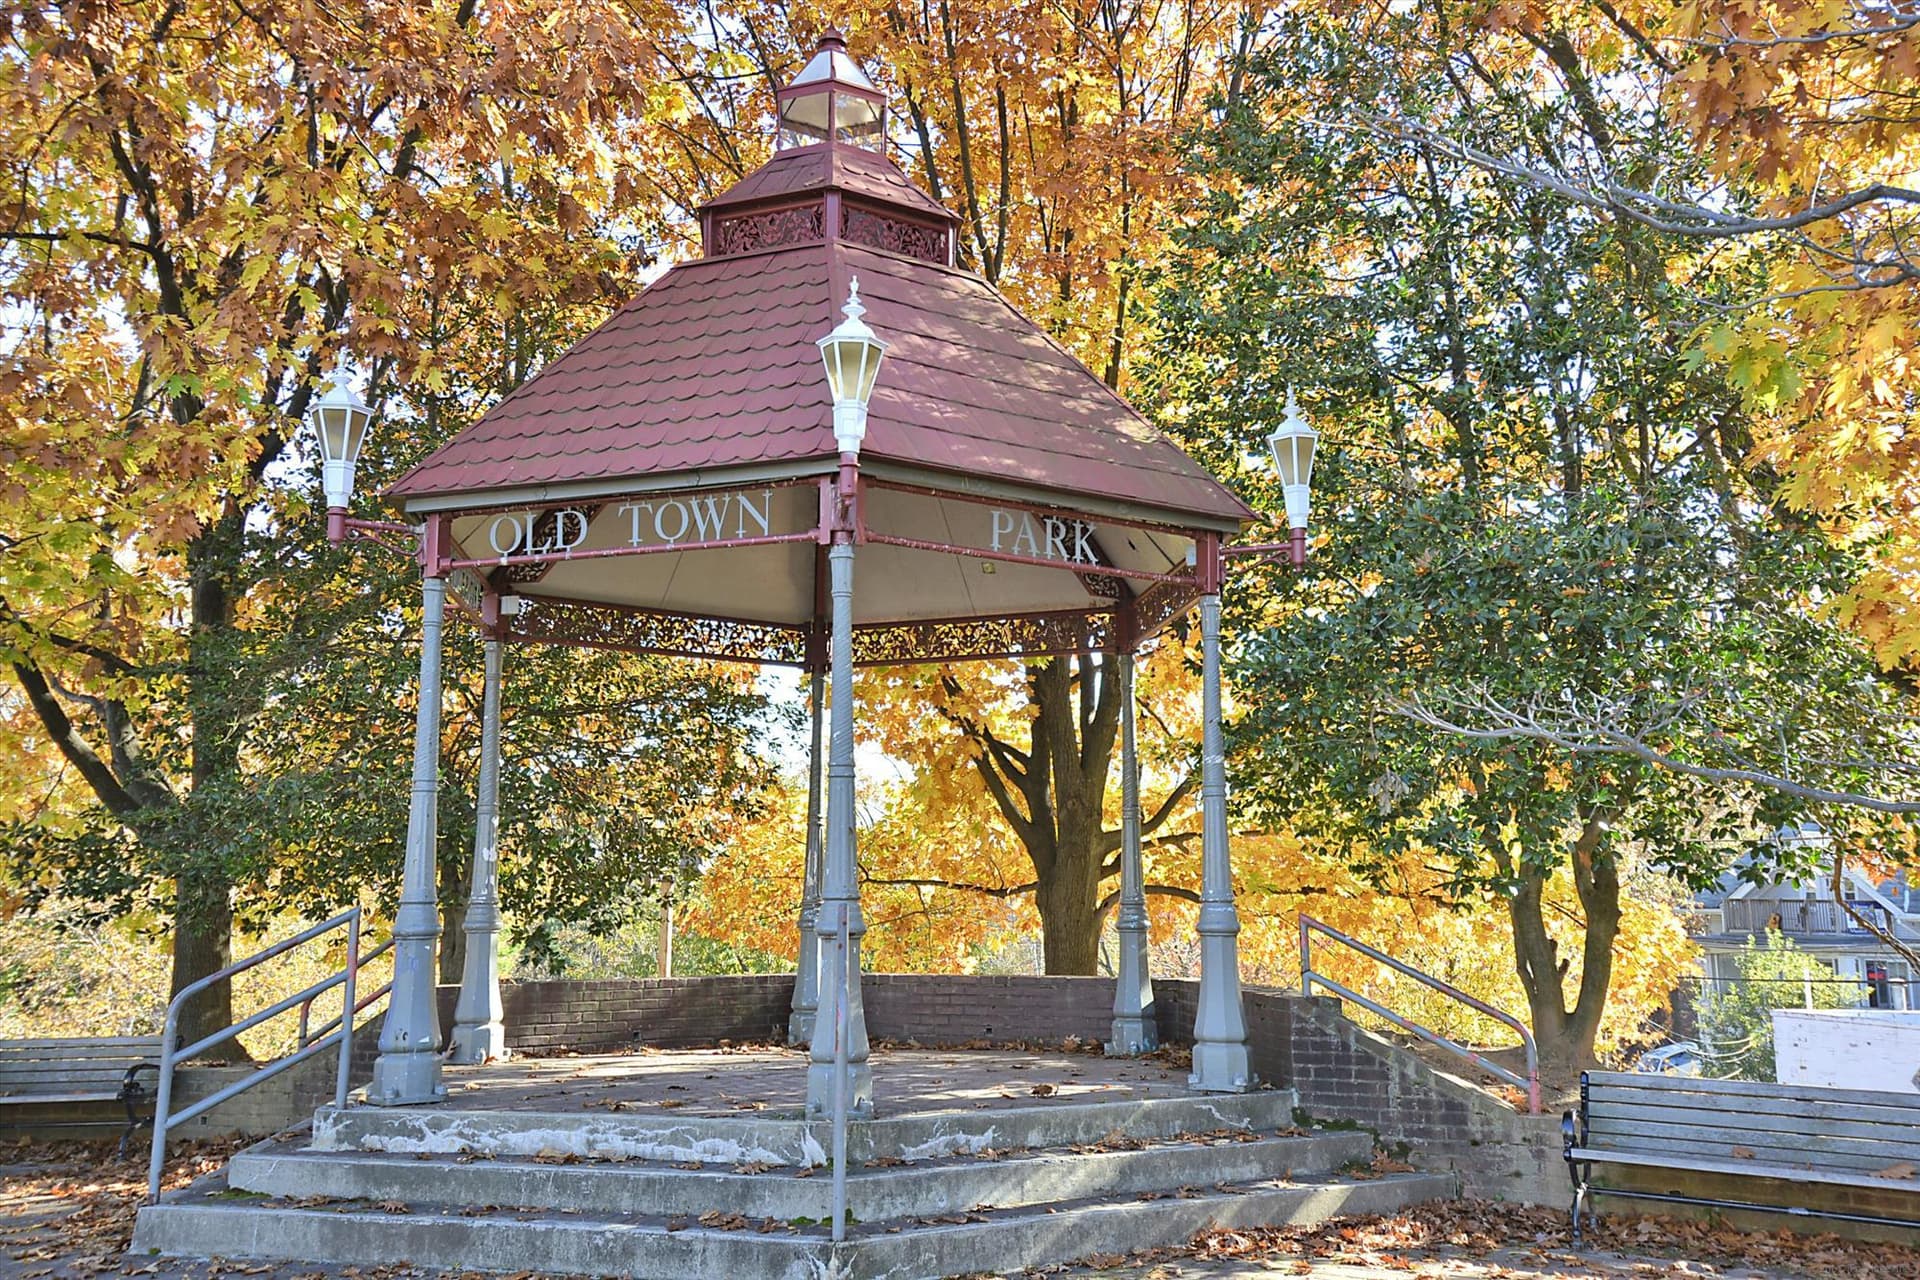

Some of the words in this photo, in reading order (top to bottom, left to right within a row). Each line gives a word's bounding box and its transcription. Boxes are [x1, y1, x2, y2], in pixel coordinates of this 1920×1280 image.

[489, 510, 588, 561] OLD
[617, 489, 773, 547] TOWN
[990, 510, 1099, 565] PARK
